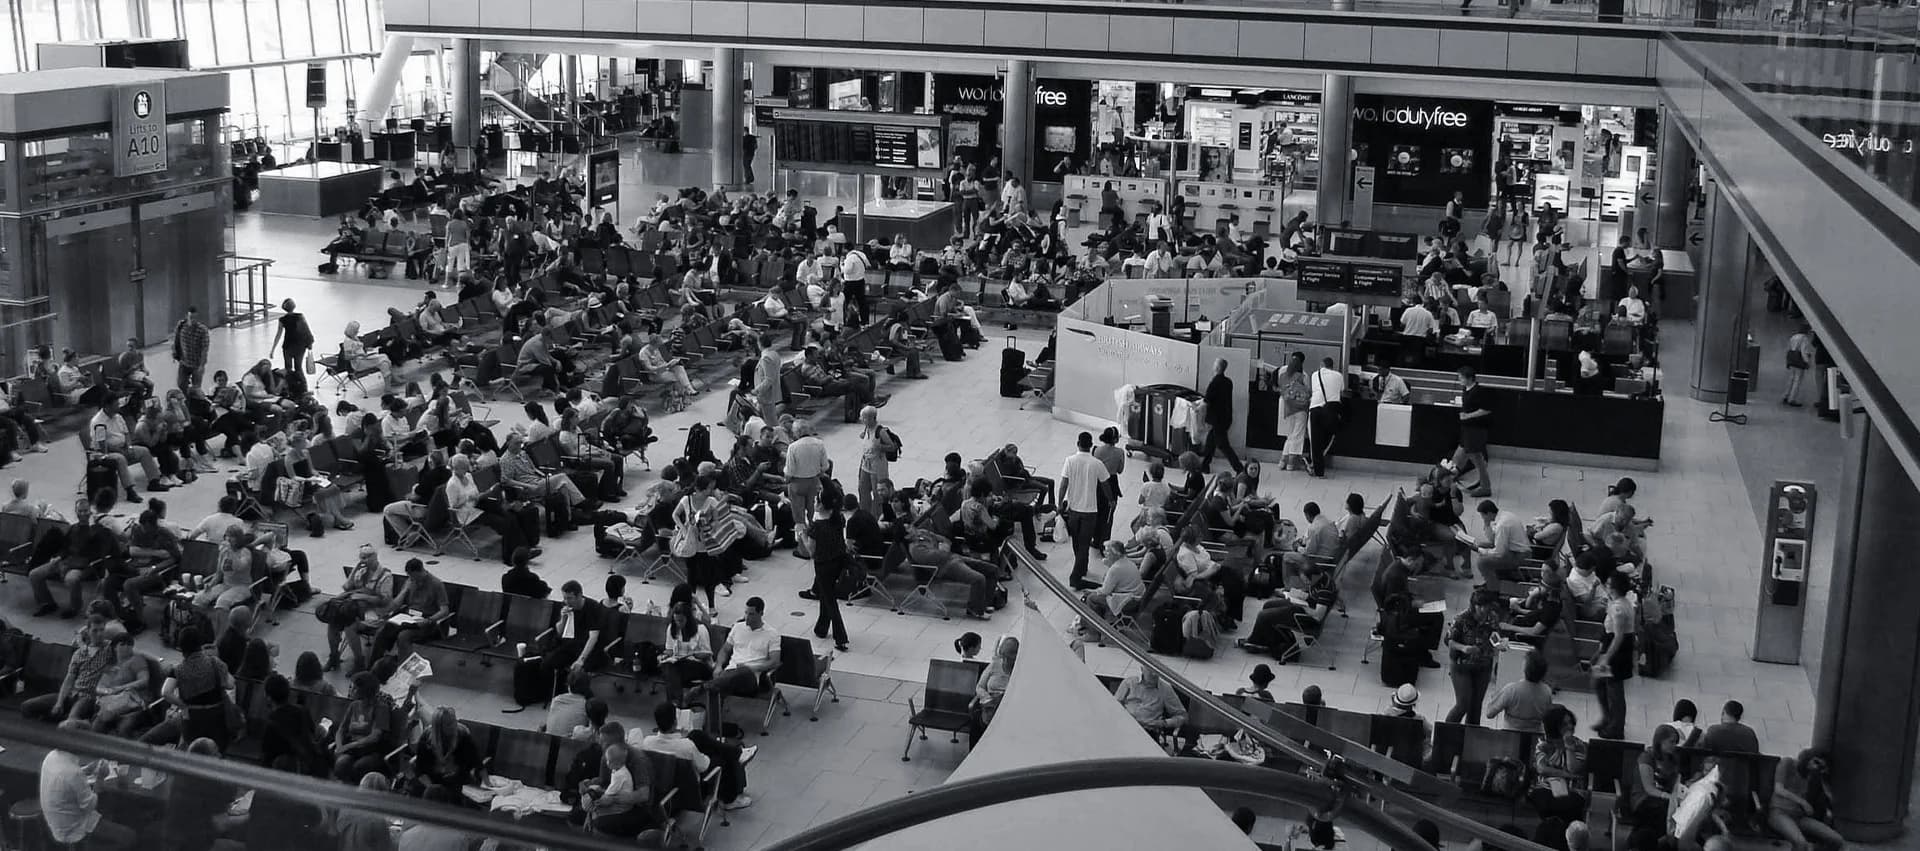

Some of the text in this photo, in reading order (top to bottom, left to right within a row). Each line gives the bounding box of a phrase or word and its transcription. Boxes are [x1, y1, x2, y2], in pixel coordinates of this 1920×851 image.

[129, 124, 158, 134] Lifts to
[127, 135, 159, 158] A10
